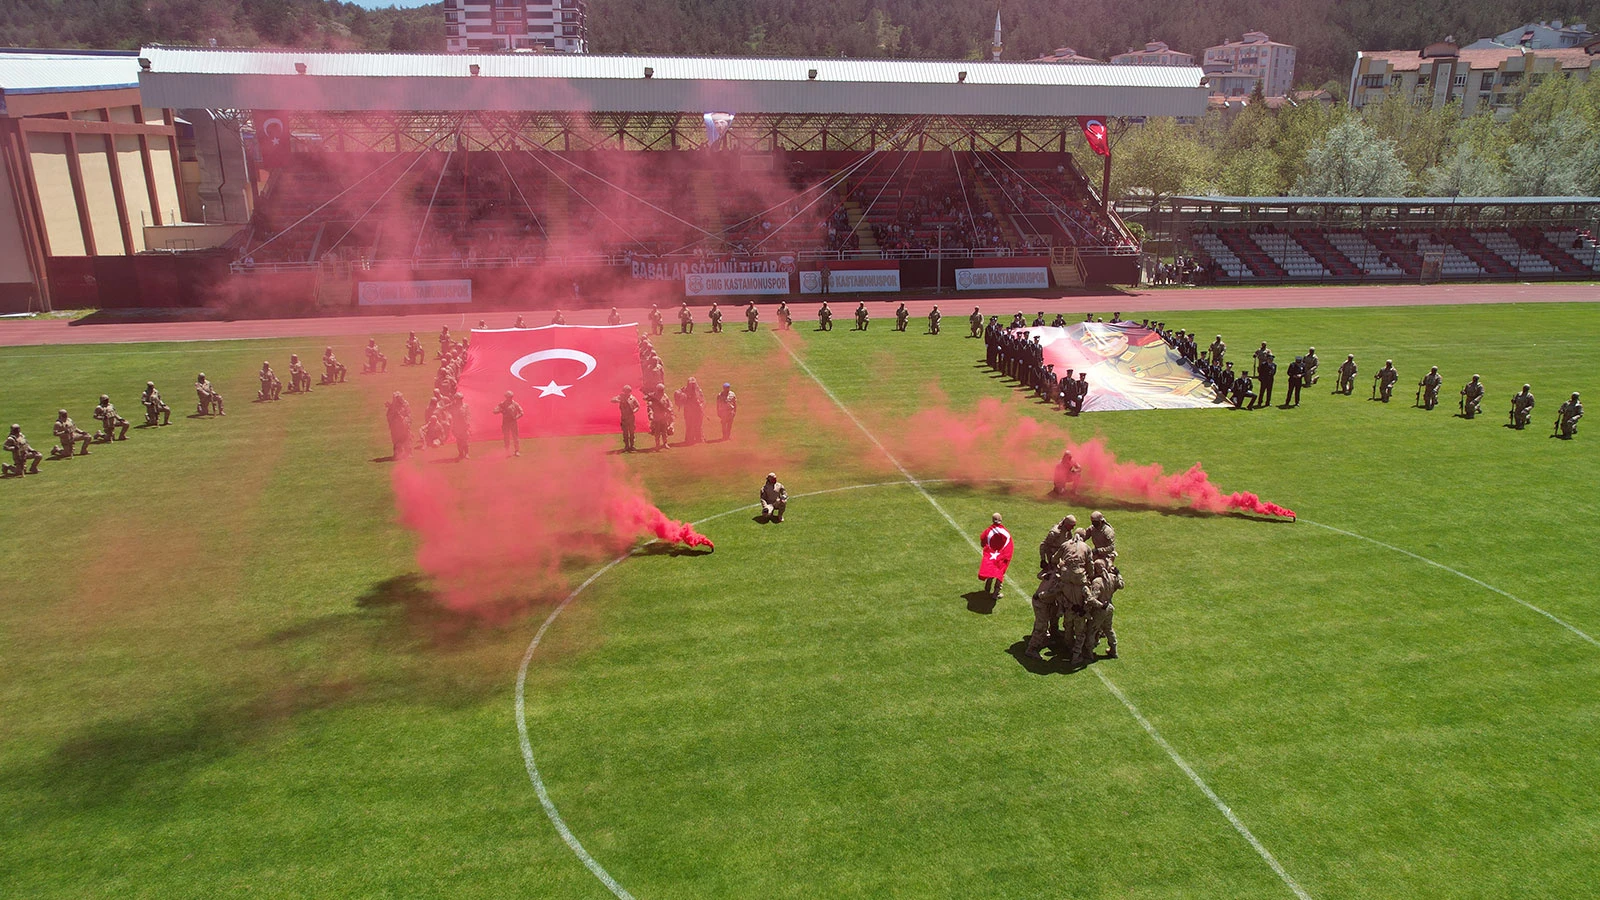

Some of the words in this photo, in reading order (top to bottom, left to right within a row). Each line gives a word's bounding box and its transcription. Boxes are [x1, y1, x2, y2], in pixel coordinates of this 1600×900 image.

[632, 260, 688, 280] BABALAR
[706, 279, 722, 290] GMG
[724, 277, 787, 290] KASTAMONUSPOR
